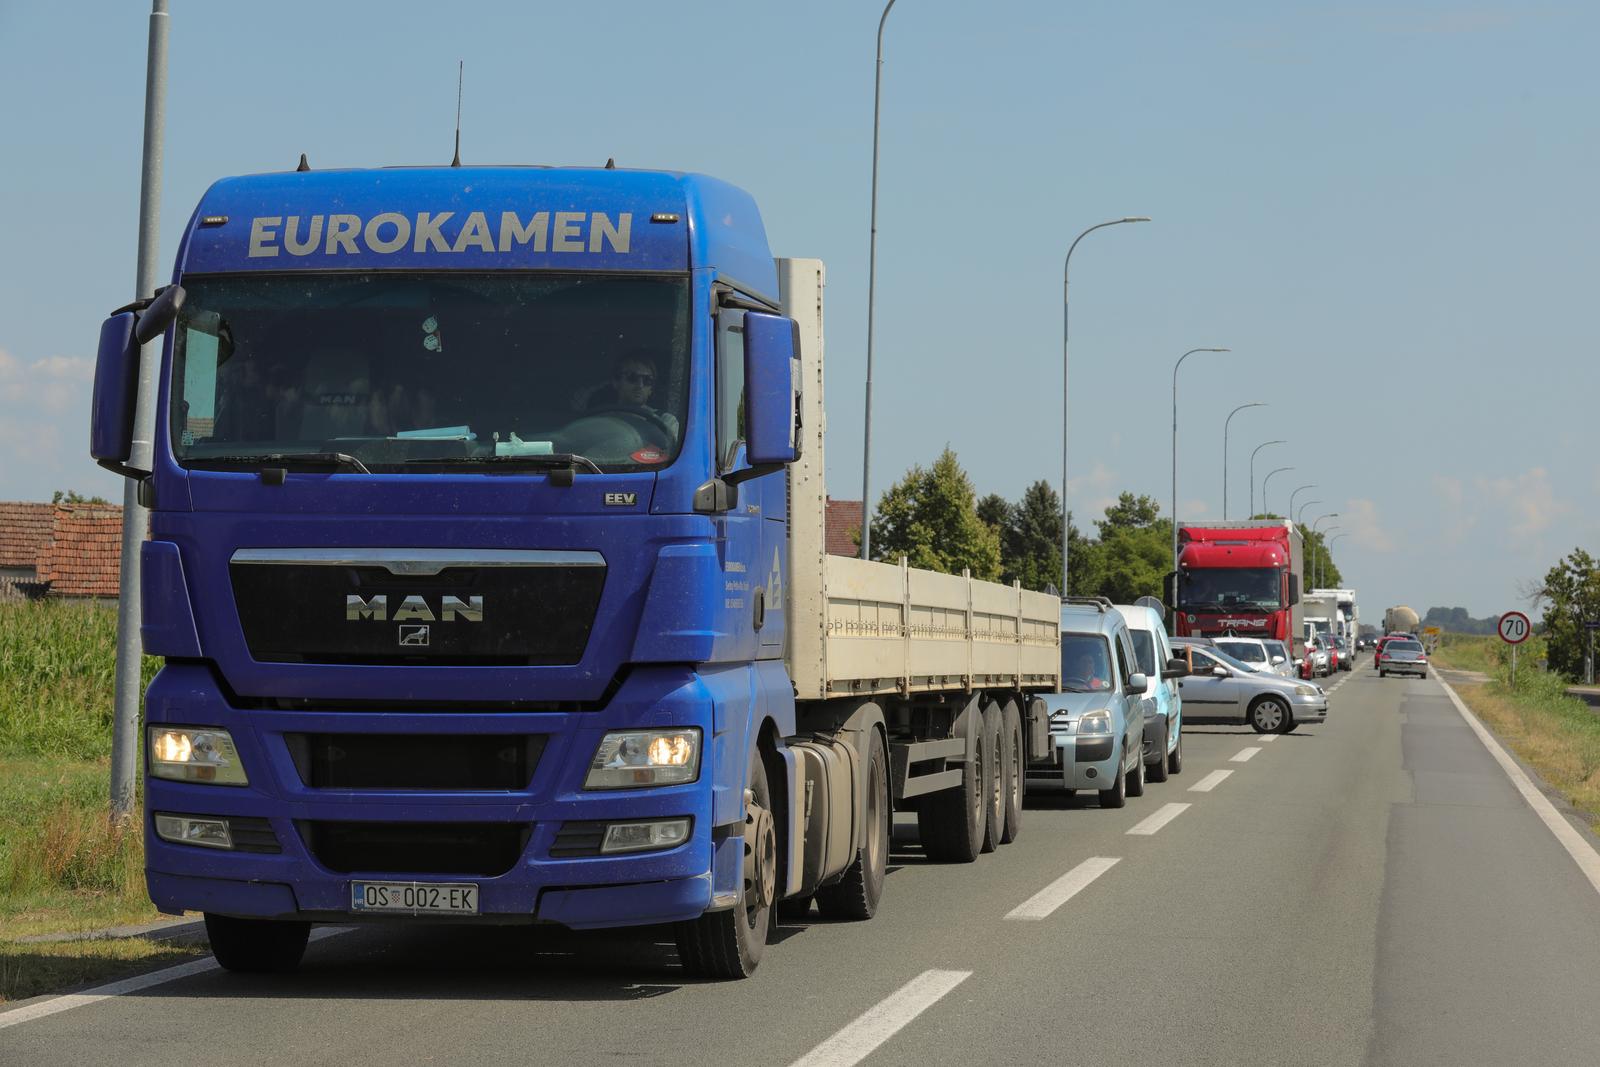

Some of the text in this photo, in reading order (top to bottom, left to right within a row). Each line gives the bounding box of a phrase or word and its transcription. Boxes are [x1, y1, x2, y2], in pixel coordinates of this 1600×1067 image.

[248, 211, 632, 257] EUROKAMEN
[605, 493, 635, 503] EEV
[346, 594, 483, 622] MAN
[1217, 618, 1268, 628] TRANS
[1505, 619, 1524, 636] 70
[366, 886, 389, 906] OS
